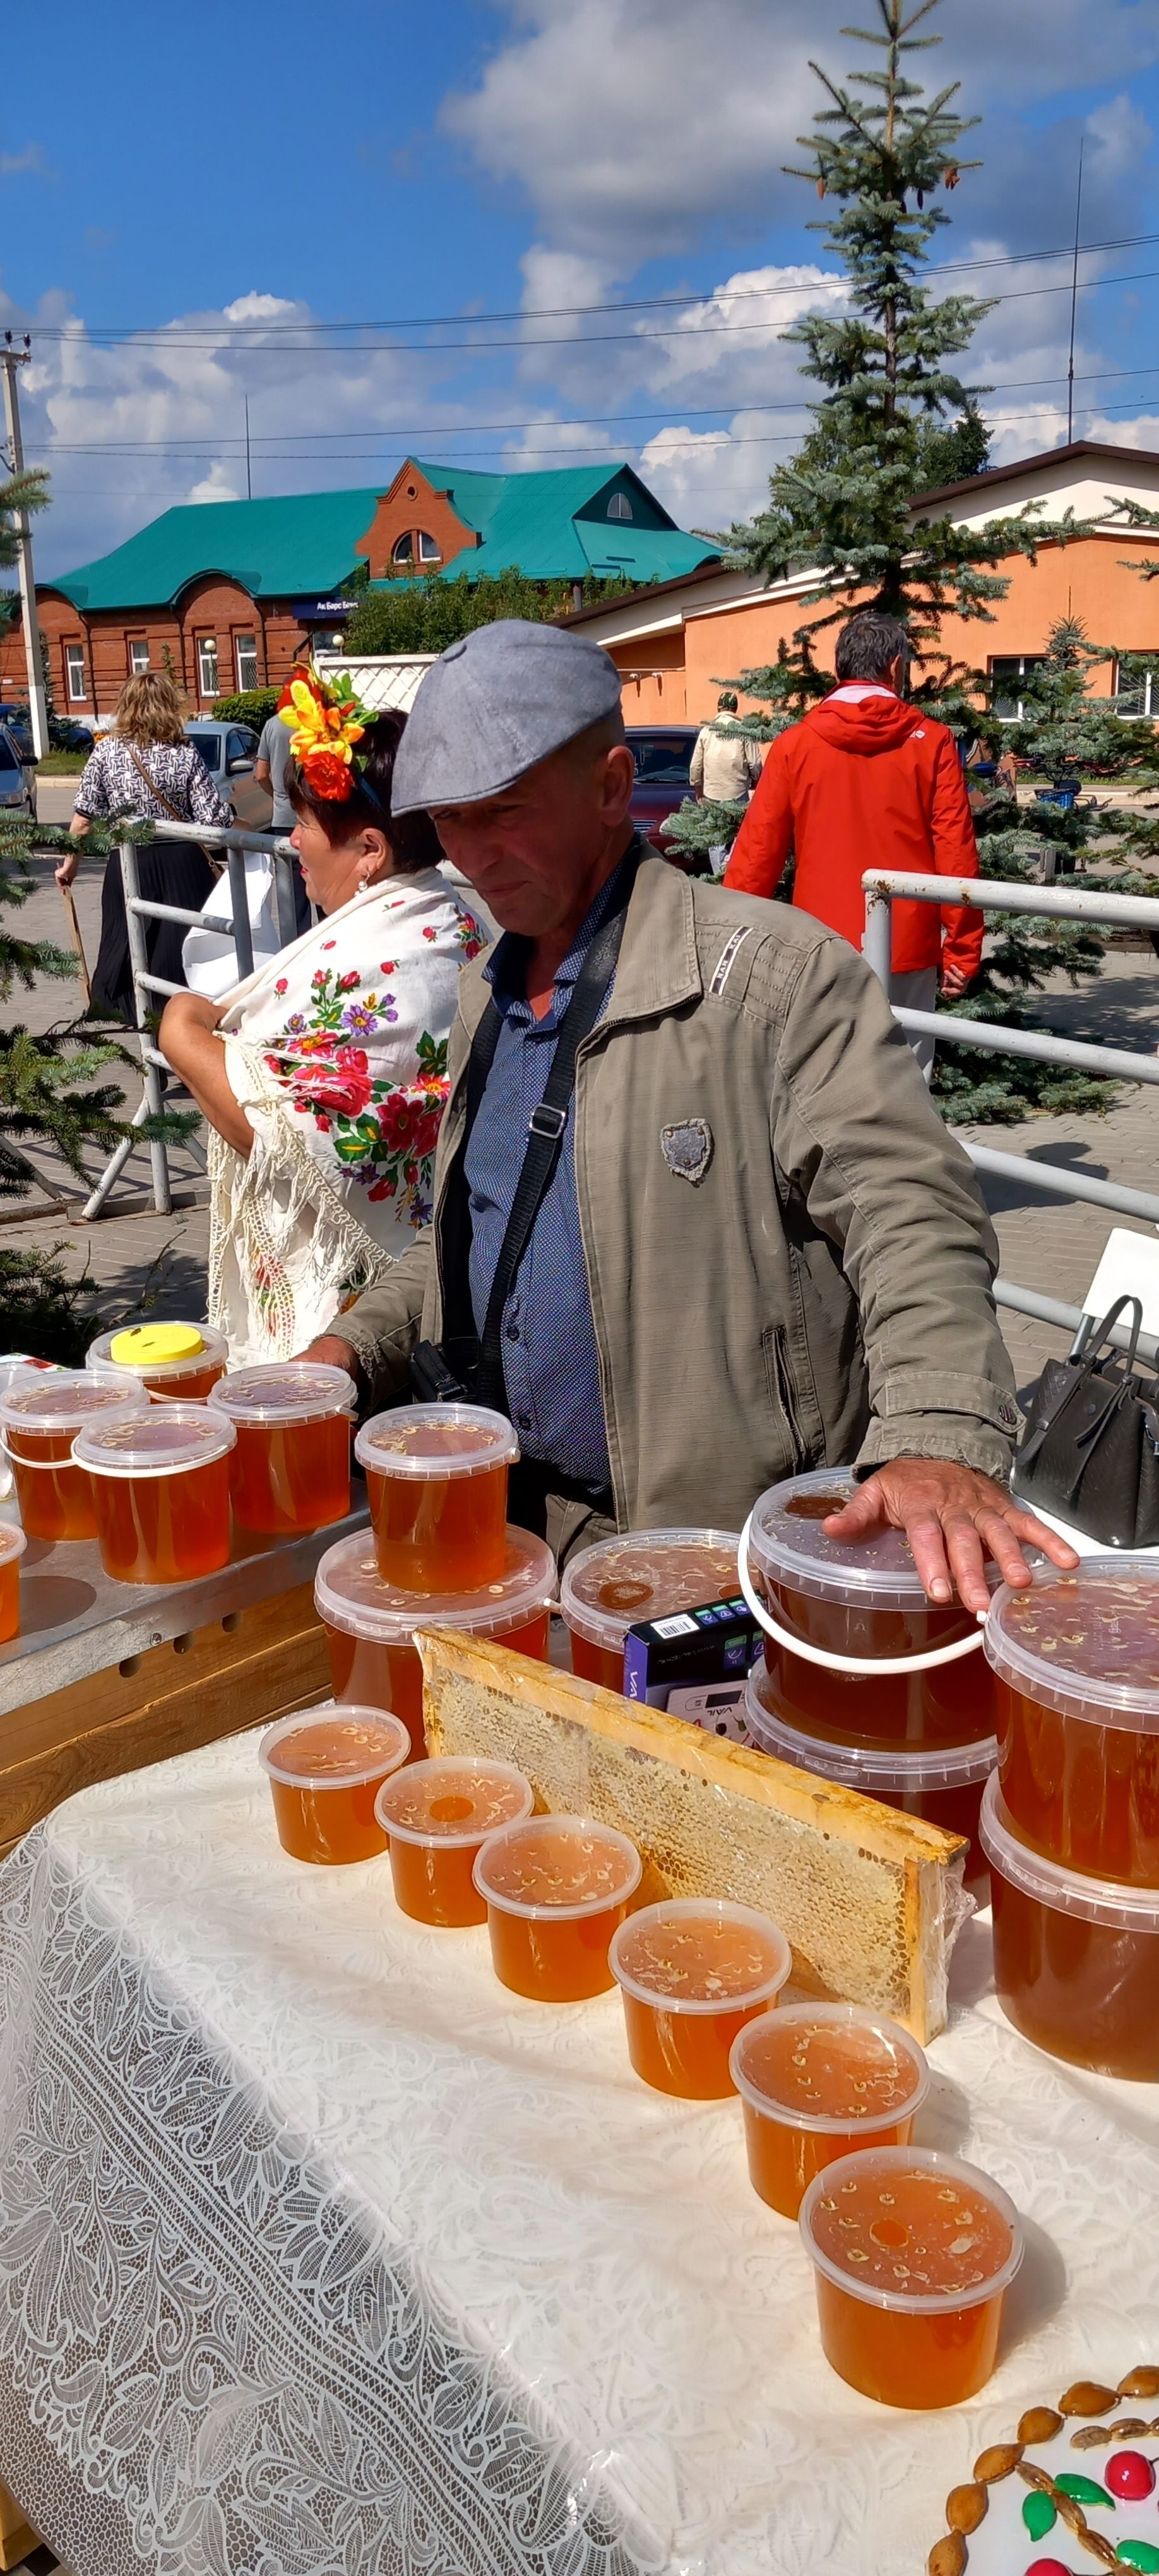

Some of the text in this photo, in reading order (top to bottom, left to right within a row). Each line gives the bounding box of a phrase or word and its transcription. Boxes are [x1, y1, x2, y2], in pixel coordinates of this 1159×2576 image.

[326, 602, 342, 611] Барс
[716, 934, 741, 979] NAN KAI
[706, 1707, 732, 1716] VAIL
[813, 1760, 848, 1774] OPEN
